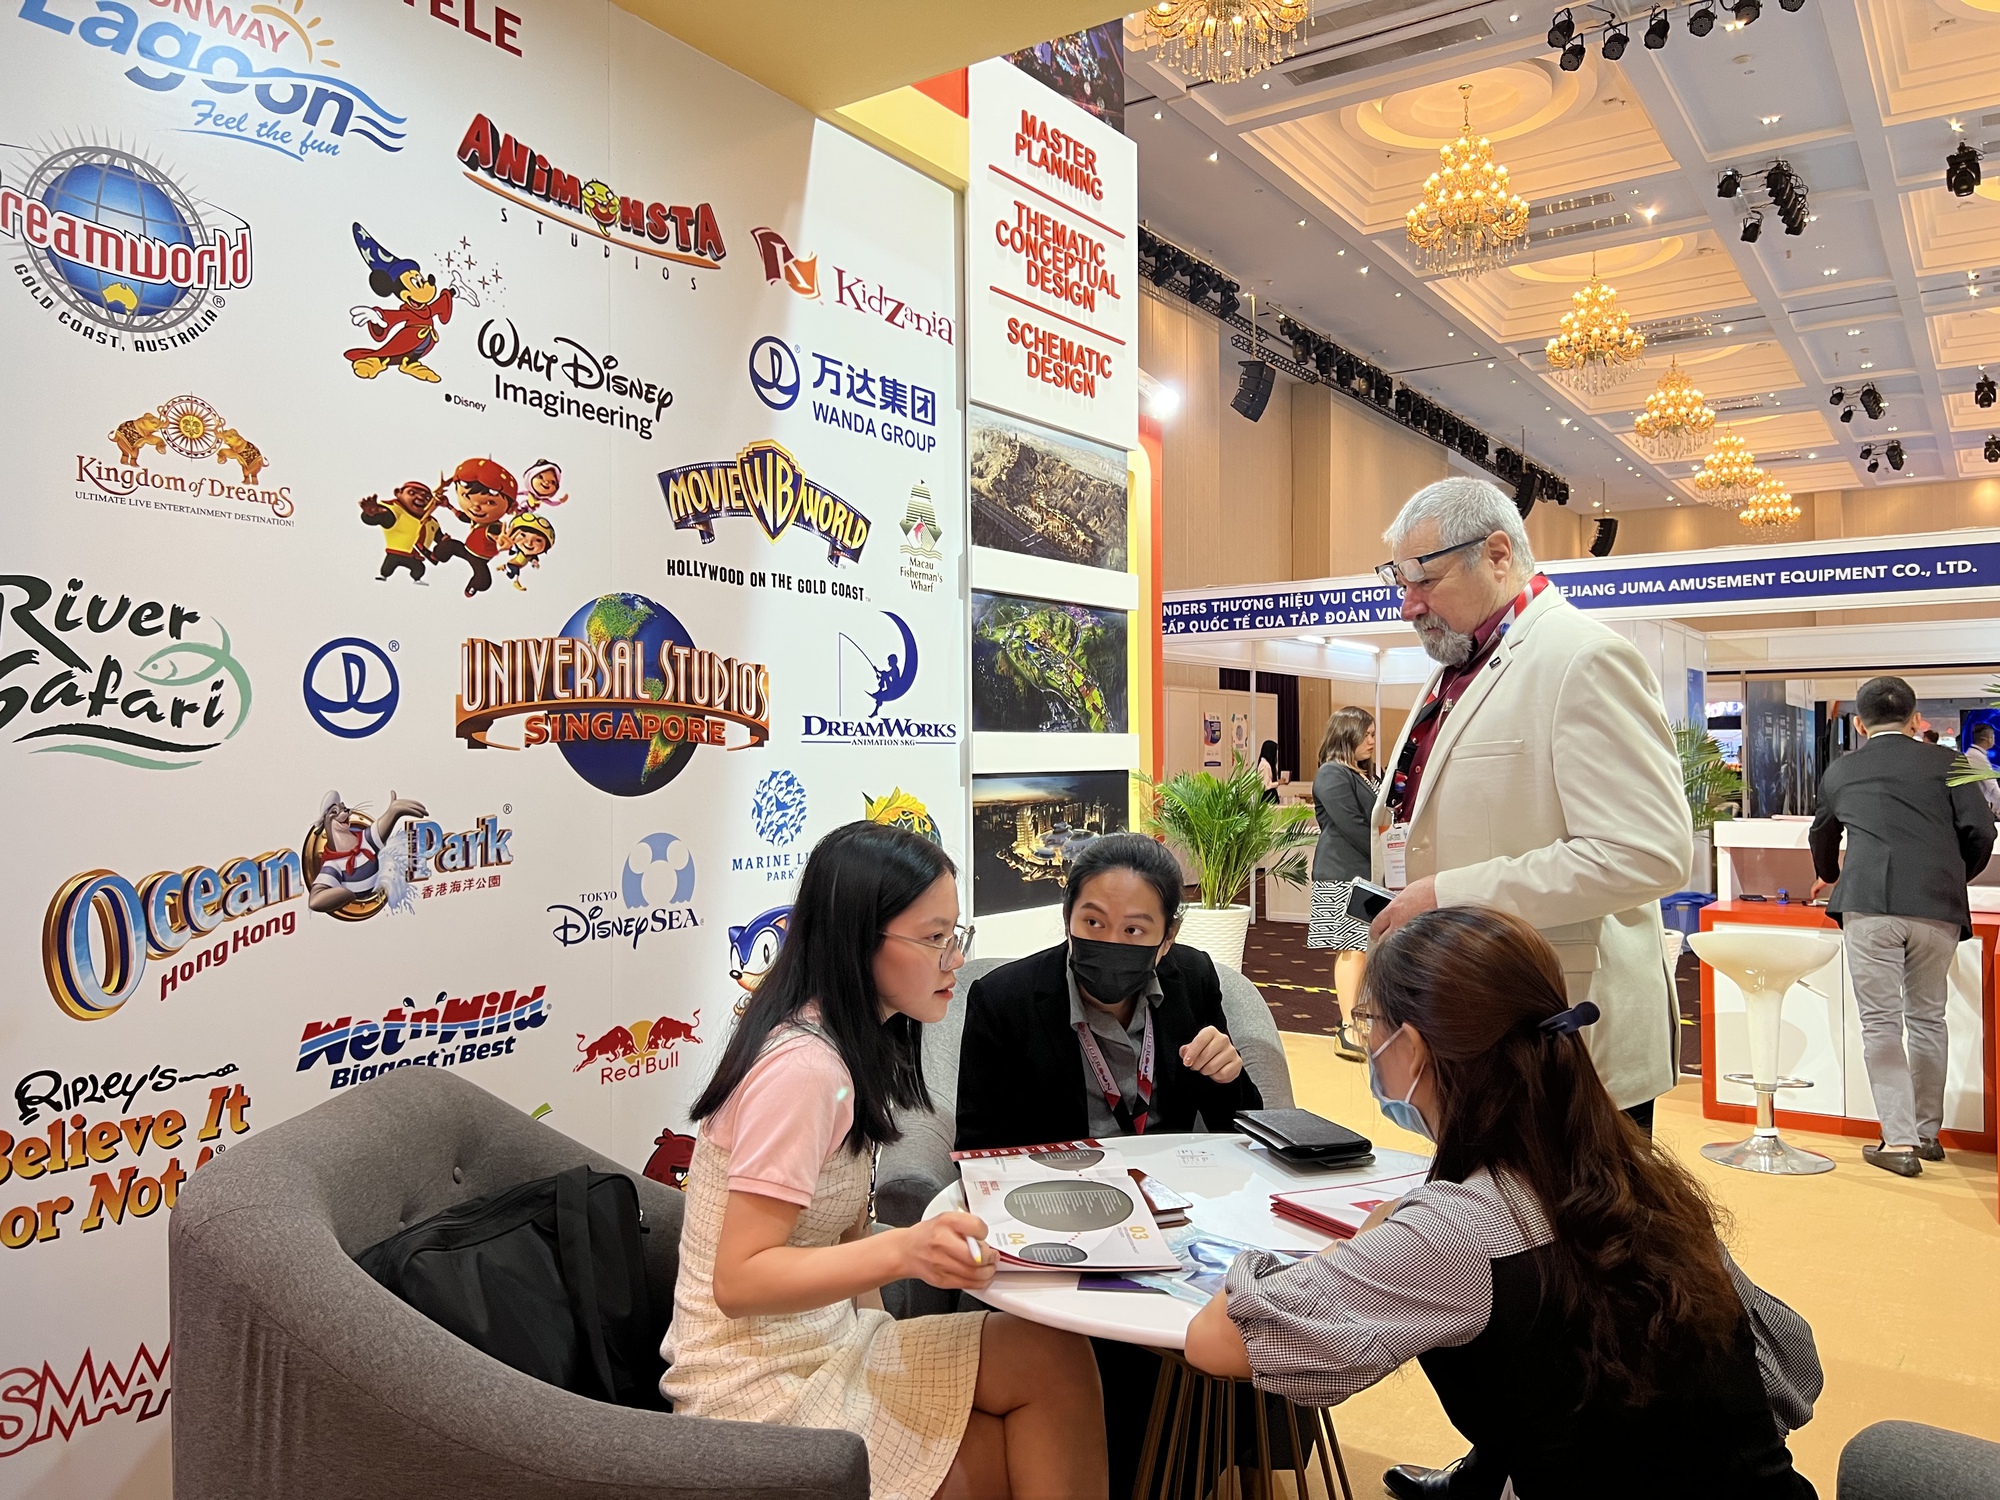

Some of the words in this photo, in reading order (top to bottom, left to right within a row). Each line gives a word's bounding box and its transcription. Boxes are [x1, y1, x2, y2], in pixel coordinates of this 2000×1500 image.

[148, 0, 290, 54] NWAY
[403, 0, 523, 58] ELE
[191, 100, 248, 132] Feel
[257, 121, 292, 144] the
[299, 138, 341, 156] fun
[1021, 109, 1097, 176] MASTER
[1015, 132, 1104, 201] PLANNING
[0, 190, 250, 286] reamworld
[501, 207, 697, 290] STUDIOS
[995, 219, 1121, 300] CONCEPTUAL
[1013, 200, 1105, 267] THEMATIC
[14, 263, 54, 310] GOLD
[58, 311, 125, 352] COAST,
[134, 309, 218, 352] AUSTRALIA
[832, 266, 954, 345] KidZania
[1026, 259, 1095, 313] DESIGN
[1007, 317, 1112, 379] SCHEMATIC
[1027, 351, 1095, 399] DESIGN
[454, 395, 487, 412] Disney
[495, 374, 653, 440] Imagineering
[812, 352, 936, 426] 万达集团
[812, 400, 877, 438] WANDA
[881, 422, 936, 453] GROUP
[75, 455, 187, 496] Kingdom
[188, 477, 206, 498] of
[668, 467, 744, 523] MOVIE
[744, 452, 794, 532] WB
[801, 481, 868, 549] WORLD
[75, 491, 126, 505] ULTIMATE
[128, 499, 152, 508] LIVE
[154, 502, 232, 519] ENTERTAINMENT
[234, 512, 294, 527] DESTINATION!
[667, 559, 744, 586] HOLLYWOOD
[750, 572, 766, 587] ON
[771, 573, 792, 590] THE
[798, 579, 826, 594] GOLD
[831, 582, 864, 601] COAST
[900, 566, 943, 583] Fisherman's
[909, 556, 934, 570] Macau
[910, 580, 933, 593] Wharf
[1619, 580, 1665, 595] JUMA
[1668, 572, 1776, 592] AMUSEMENT
[1780, 565, 1888, 585] EQUIPMENT
[1891, 563, 1931, 578] CO.,
[1936, 560, 1978, 575] LTD.
[0, 575, 200, 673] River
[1163, 603, 1207, 616] NDERS
[1211, 598, 1274, 613] THƯƠNG
[1319, 592, 1346, 605] VUI
[1352, 588, 1390, 603] CHƠI
[1189, 614, 1229, 634] QUỐC
[1233, 613, 1251, 629] TẾ
[1325, 607, 1370, 624] ĐOÀN
[461, 637, 651, 712] UNIVERSAL
[653, 640, 768, 722] STUDIOS
[524, 710, 726, 746] SINGAPORE
[421, 875, 501, 899] 香港海洋公園
[732, 854, 790, 871] MARINE
[767, 870, 795, 881] PARK
[42, 848, 303, 1021] Ocean
[405, 814, 513, 881] Park
[580, 890, 618, 903] TOKYO
[160, 943, 229, 1001] Hong
[233, 910, 297, 955] Kong
[601, 1063, 641, 1085] Red
[645, 1052, 679, 1075] Bull
[198, 1083, 250, 1142] It
[0, 1196, 73, 1249] or
